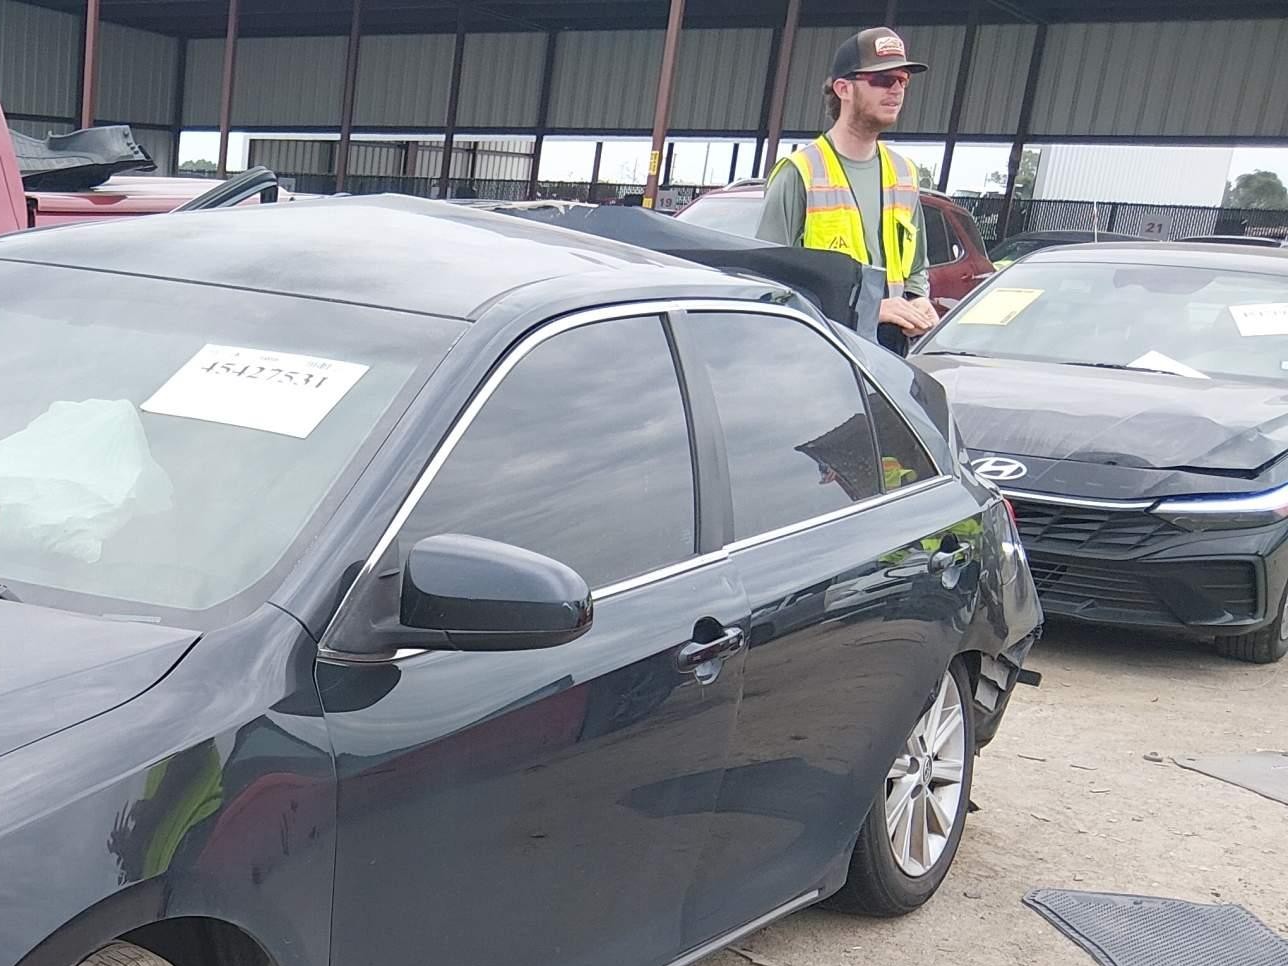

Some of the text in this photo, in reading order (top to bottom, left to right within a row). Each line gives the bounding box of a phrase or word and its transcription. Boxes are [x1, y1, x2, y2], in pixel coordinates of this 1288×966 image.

[659, 198, 673, 208] 19
[1144, 222, 1163, 234] 21
[201, 361, 328, 388] 45427531
